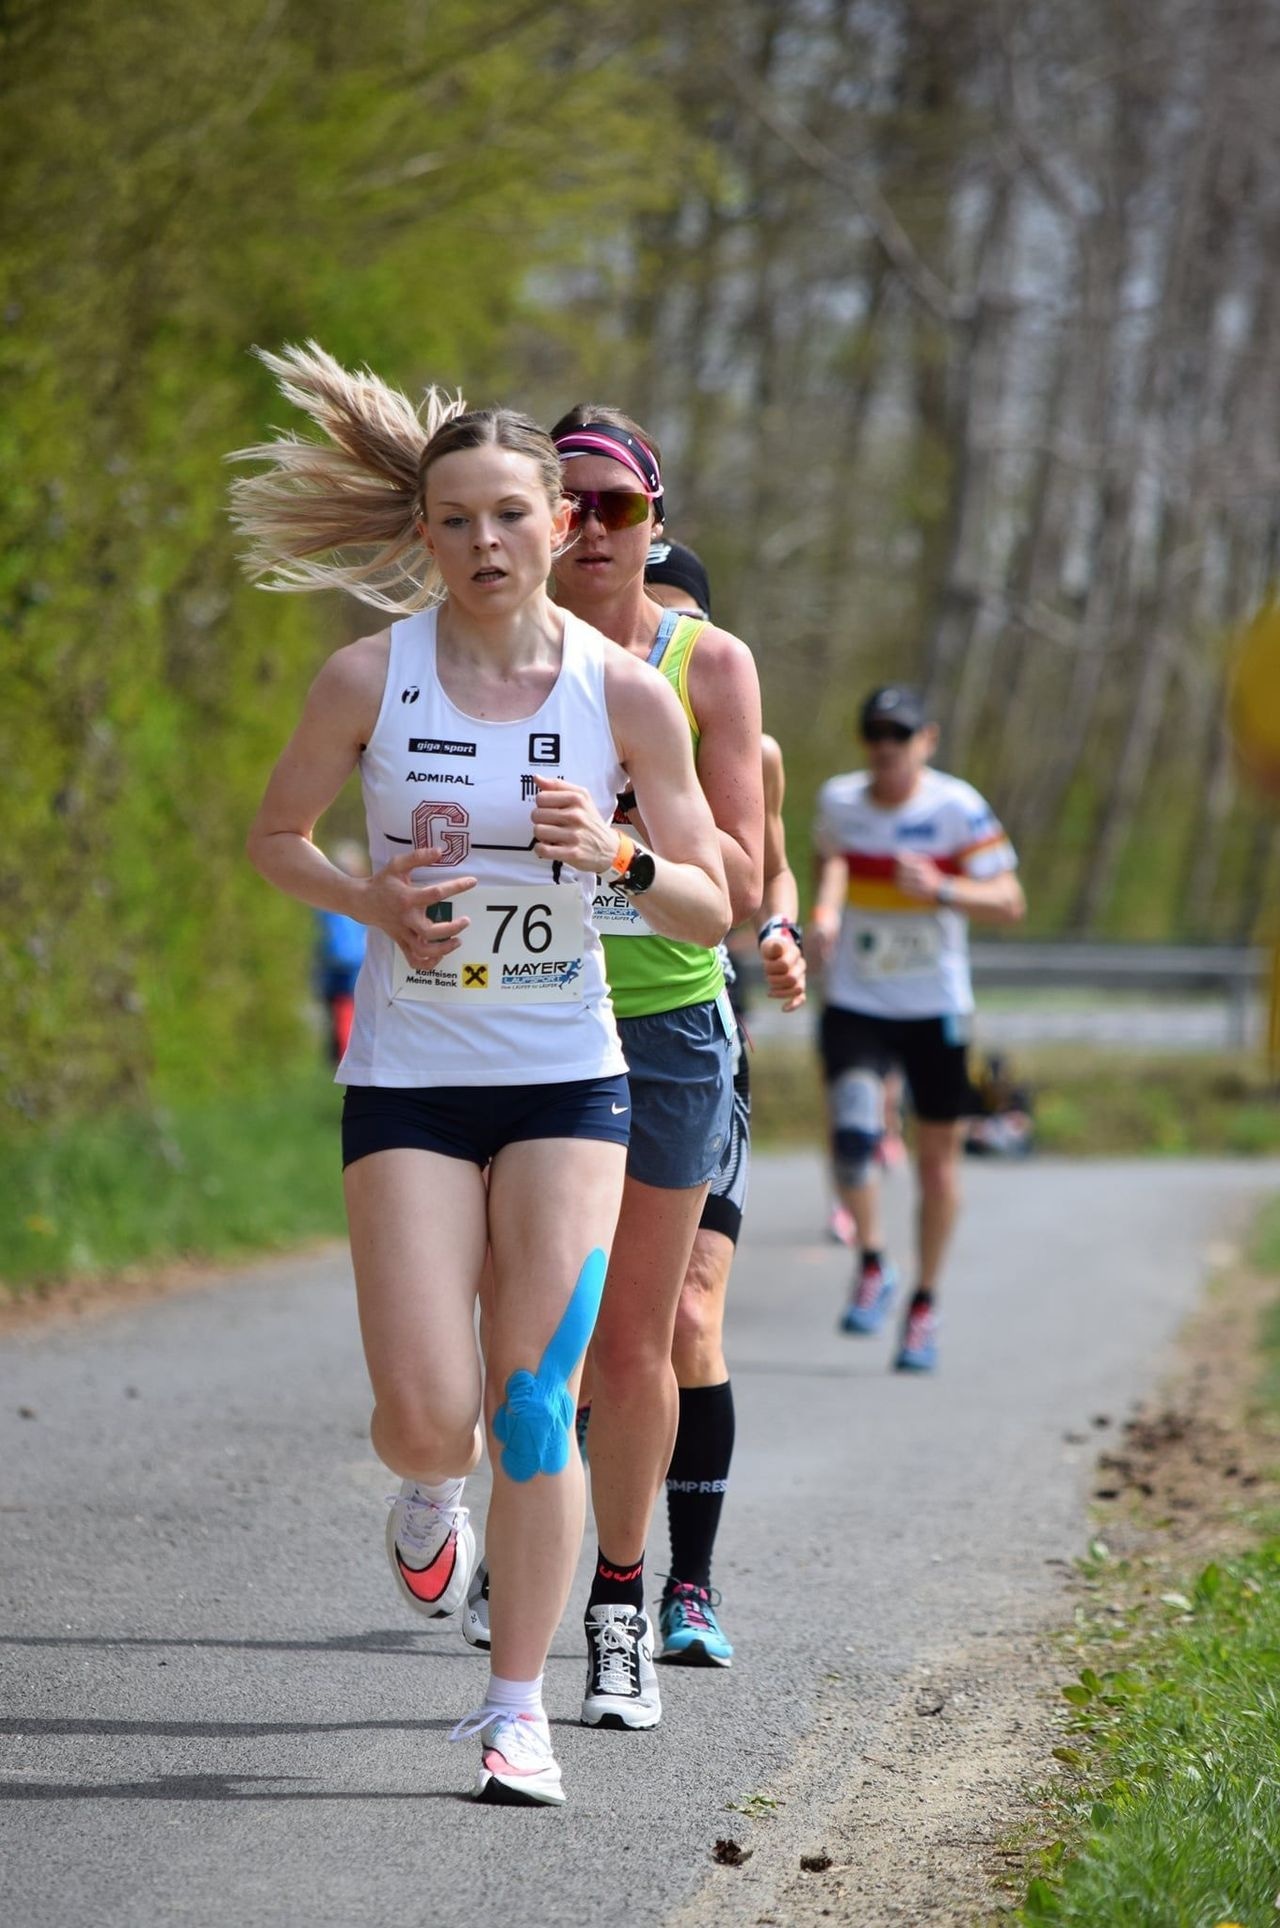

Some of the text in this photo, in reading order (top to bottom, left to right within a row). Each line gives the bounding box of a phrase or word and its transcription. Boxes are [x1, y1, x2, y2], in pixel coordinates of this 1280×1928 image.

[416, 740, 474, 754] giga sport
[406, 770, 475, 786] ADMIRAL
[411, 800, 470, 867] G
[592, 895, 630, 908] AYE
[485, 902, 553, 955] 76
[503, 962, 567, 976] MAYER
[405, 975, 458, 988] Meine Bank
